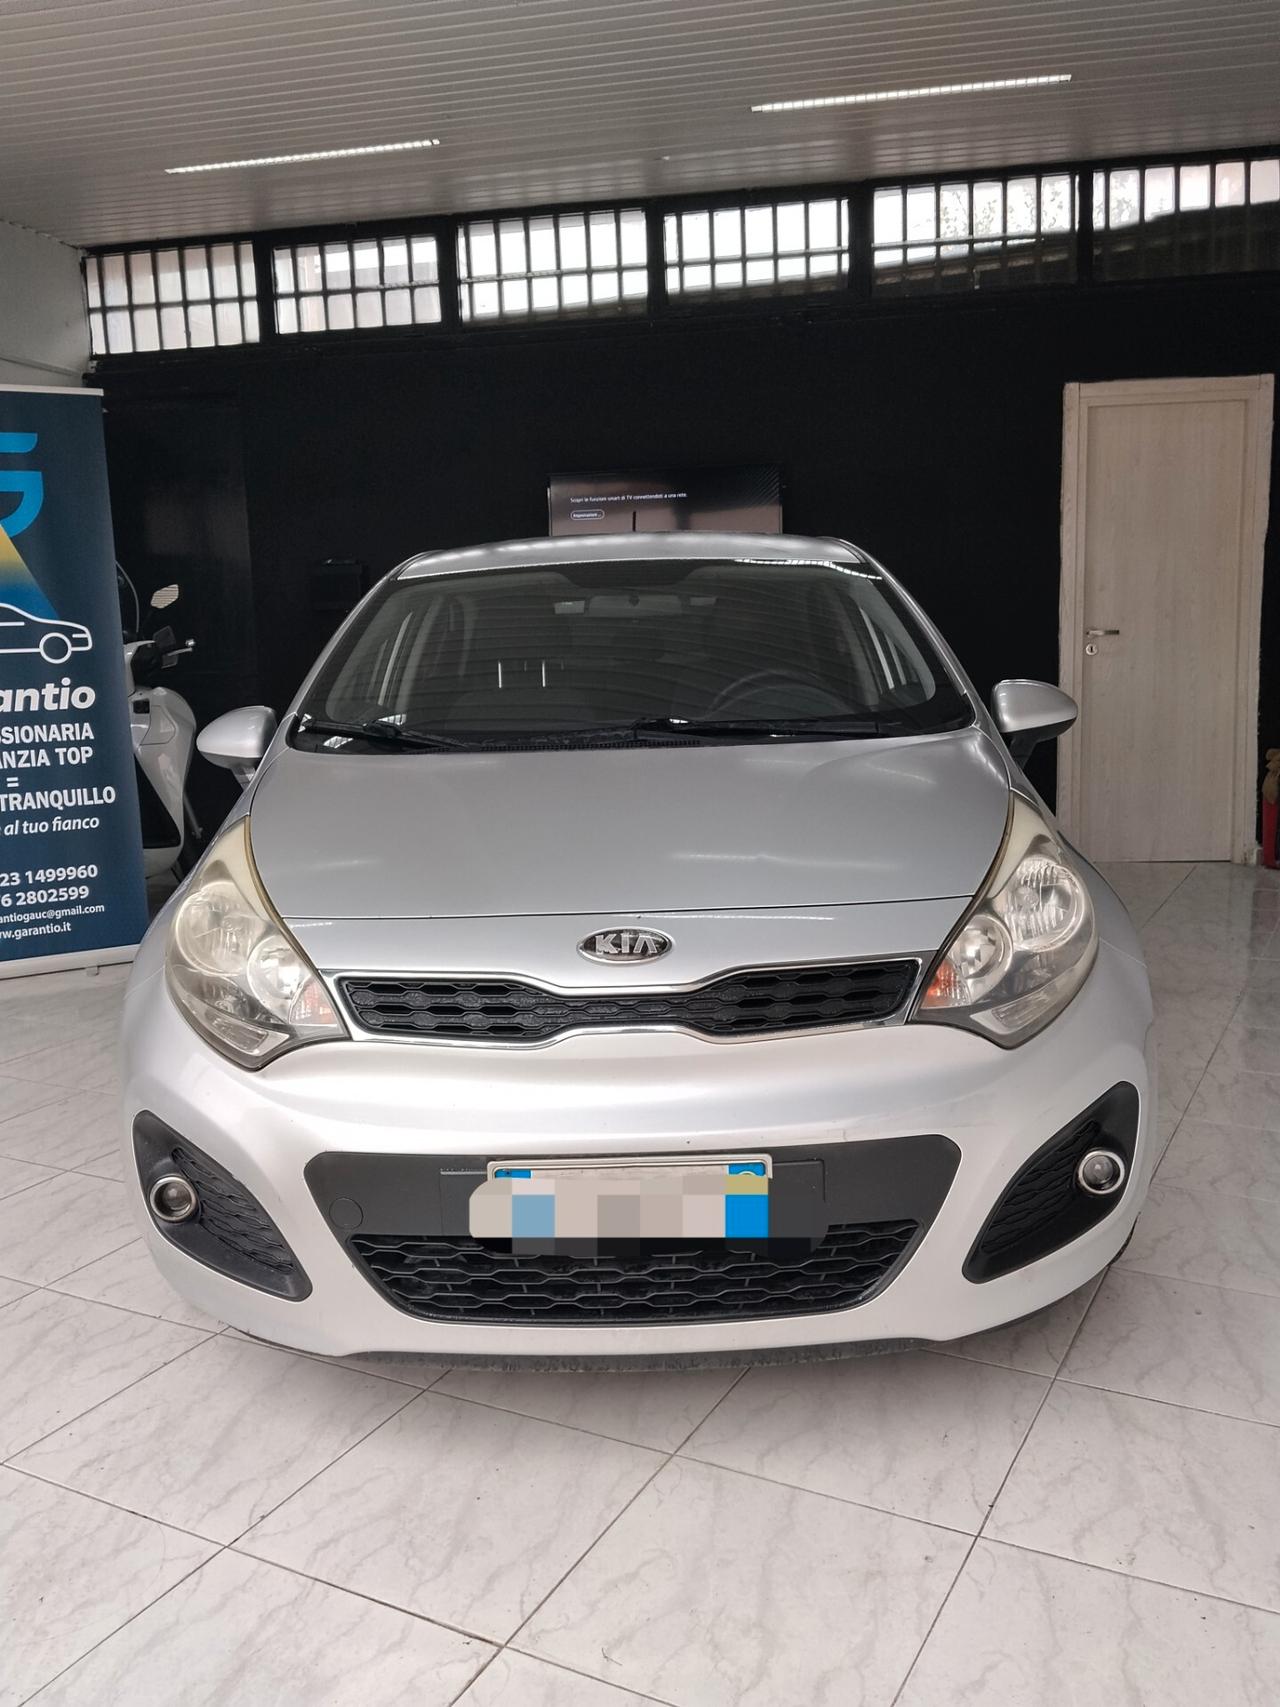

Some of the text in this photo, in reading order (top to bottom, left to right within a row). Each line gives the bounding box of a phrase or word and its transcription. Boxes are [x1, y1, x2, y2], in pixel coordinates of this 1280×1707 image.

[0, 722, 94, 745] SIONARIA
[55, 746, 93, 765] TOP
[0, 786, 116, 812] TRANQUILLO
[4, 816, 100, 836] al tuo fianco
[25, 864, 98, 884] 1499960
[0, 885, 89, 907] 6 2802599
[595, 932, 658, 955] KIA
